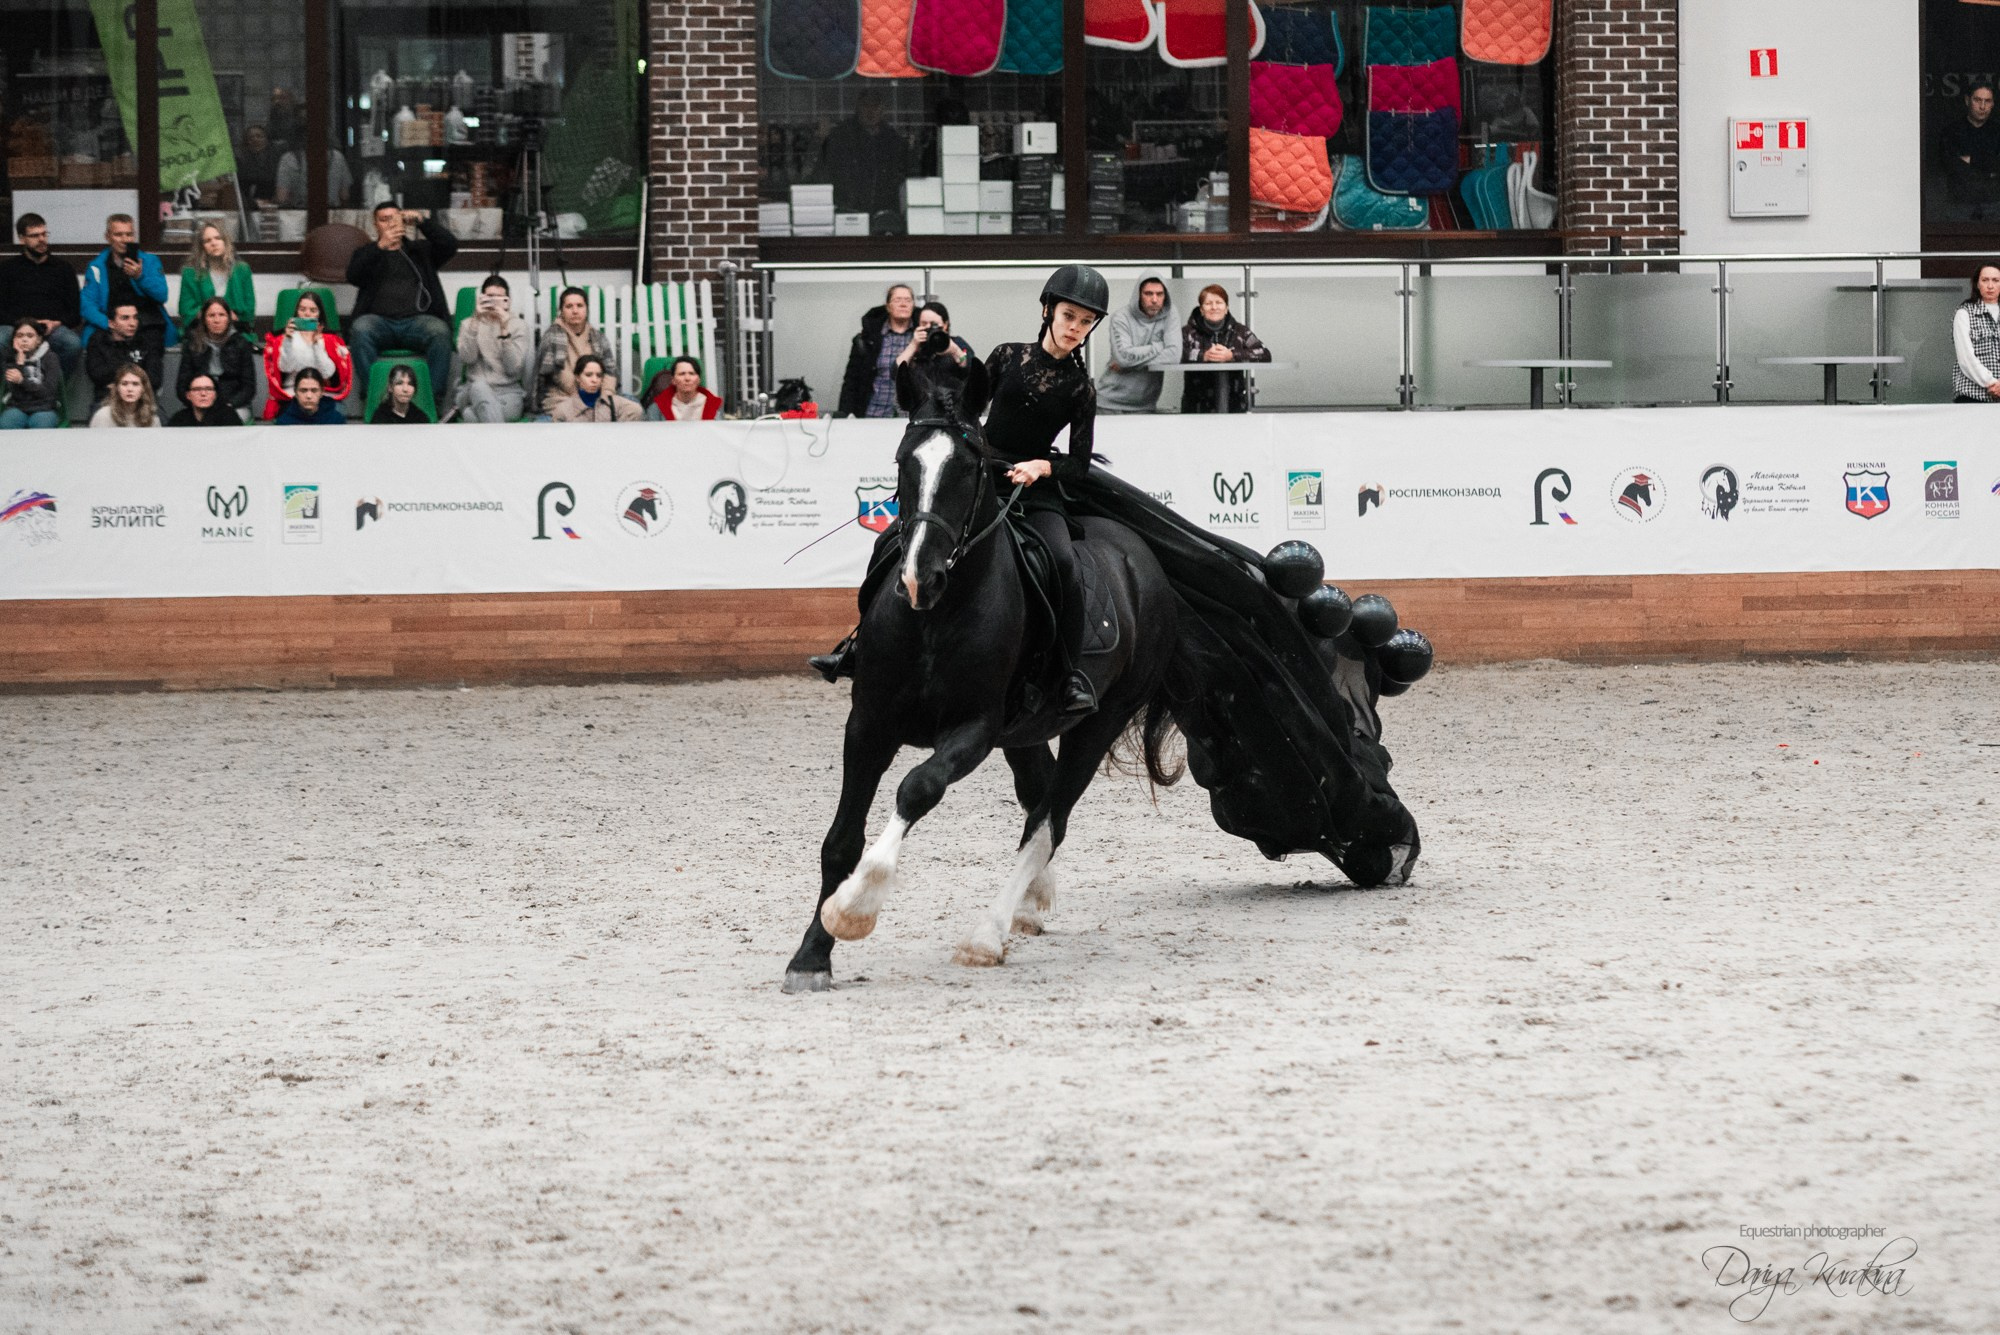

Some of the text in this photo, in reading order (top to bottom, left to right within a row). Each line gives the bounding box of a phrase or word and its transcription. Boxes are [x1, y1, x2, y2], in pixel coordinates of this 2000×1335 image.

[1389, 487, 1502, 499] РОСПЛЕМКОНЗАВОД
[91, 504, 165, 515] КРЫЛАТЫЙ
[387, 501, 504, 512] РОСПЛЕМКОНЗАВОД
[91, 515, 167, 528] ЭКЛИПС
